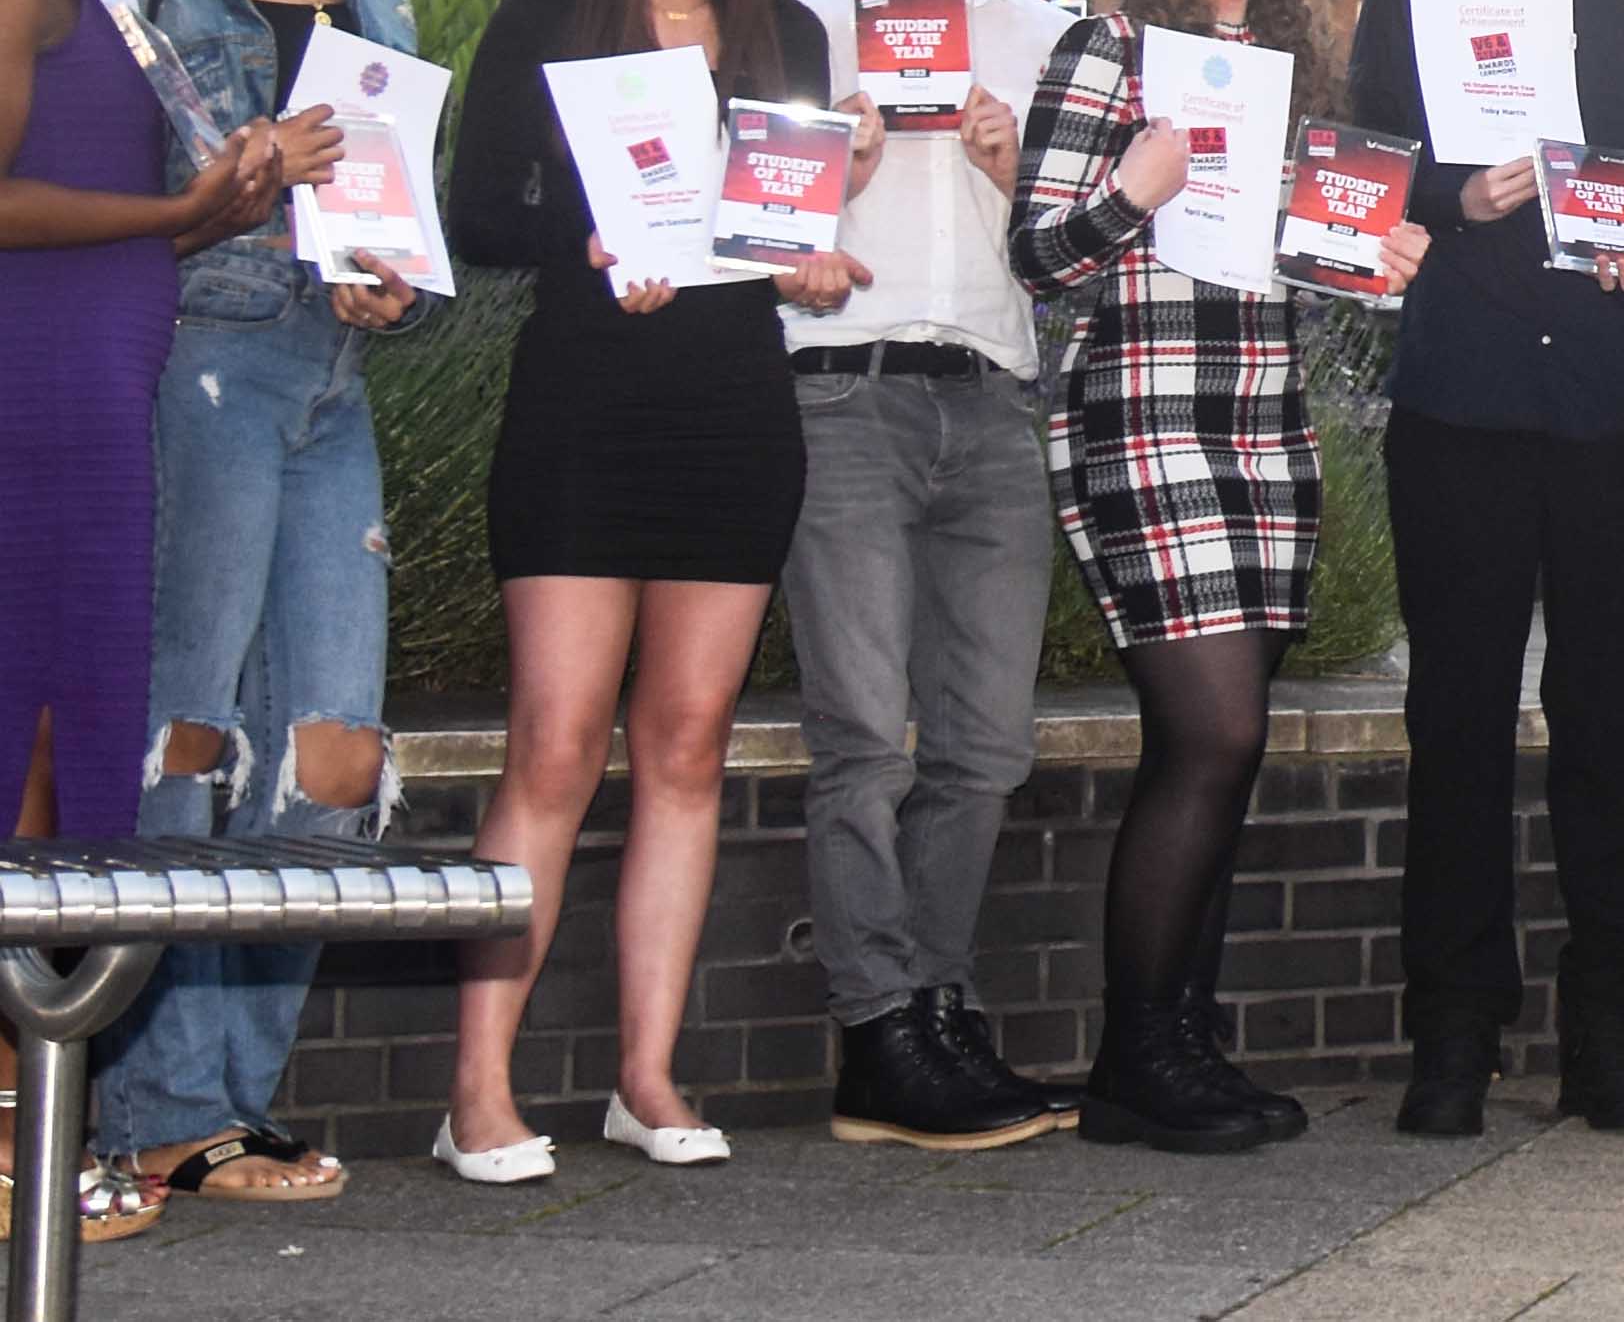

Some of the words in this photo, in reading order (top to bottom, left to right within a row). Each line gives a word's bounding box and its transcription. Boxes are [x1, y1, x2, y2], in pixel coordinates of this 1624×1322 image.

[875, 19, 948, 32] STUDENT
[883, 33, 905, 45] OF
[909, 32, 941, 44] THE
[892, 46, 934, 58] YEAR
[1478, 59, 1515, 70] AWARDS
[746, 151, 825, 174] STUDENT
[752, 166, 778, 180] OF
[779, 169, 815, 185] THE
[1314, 168, 1388, 197] STUDENT
[758, 180, 805, 197] YEAR
[1319, 184, 1344, 200] OF
[1344, 189, 1378, 208] THE
[1574, 189, 1596, 200] OF
[1324, 199, 1368, 219] YEAR
[1584, 200, 1623, 213] YEAR
